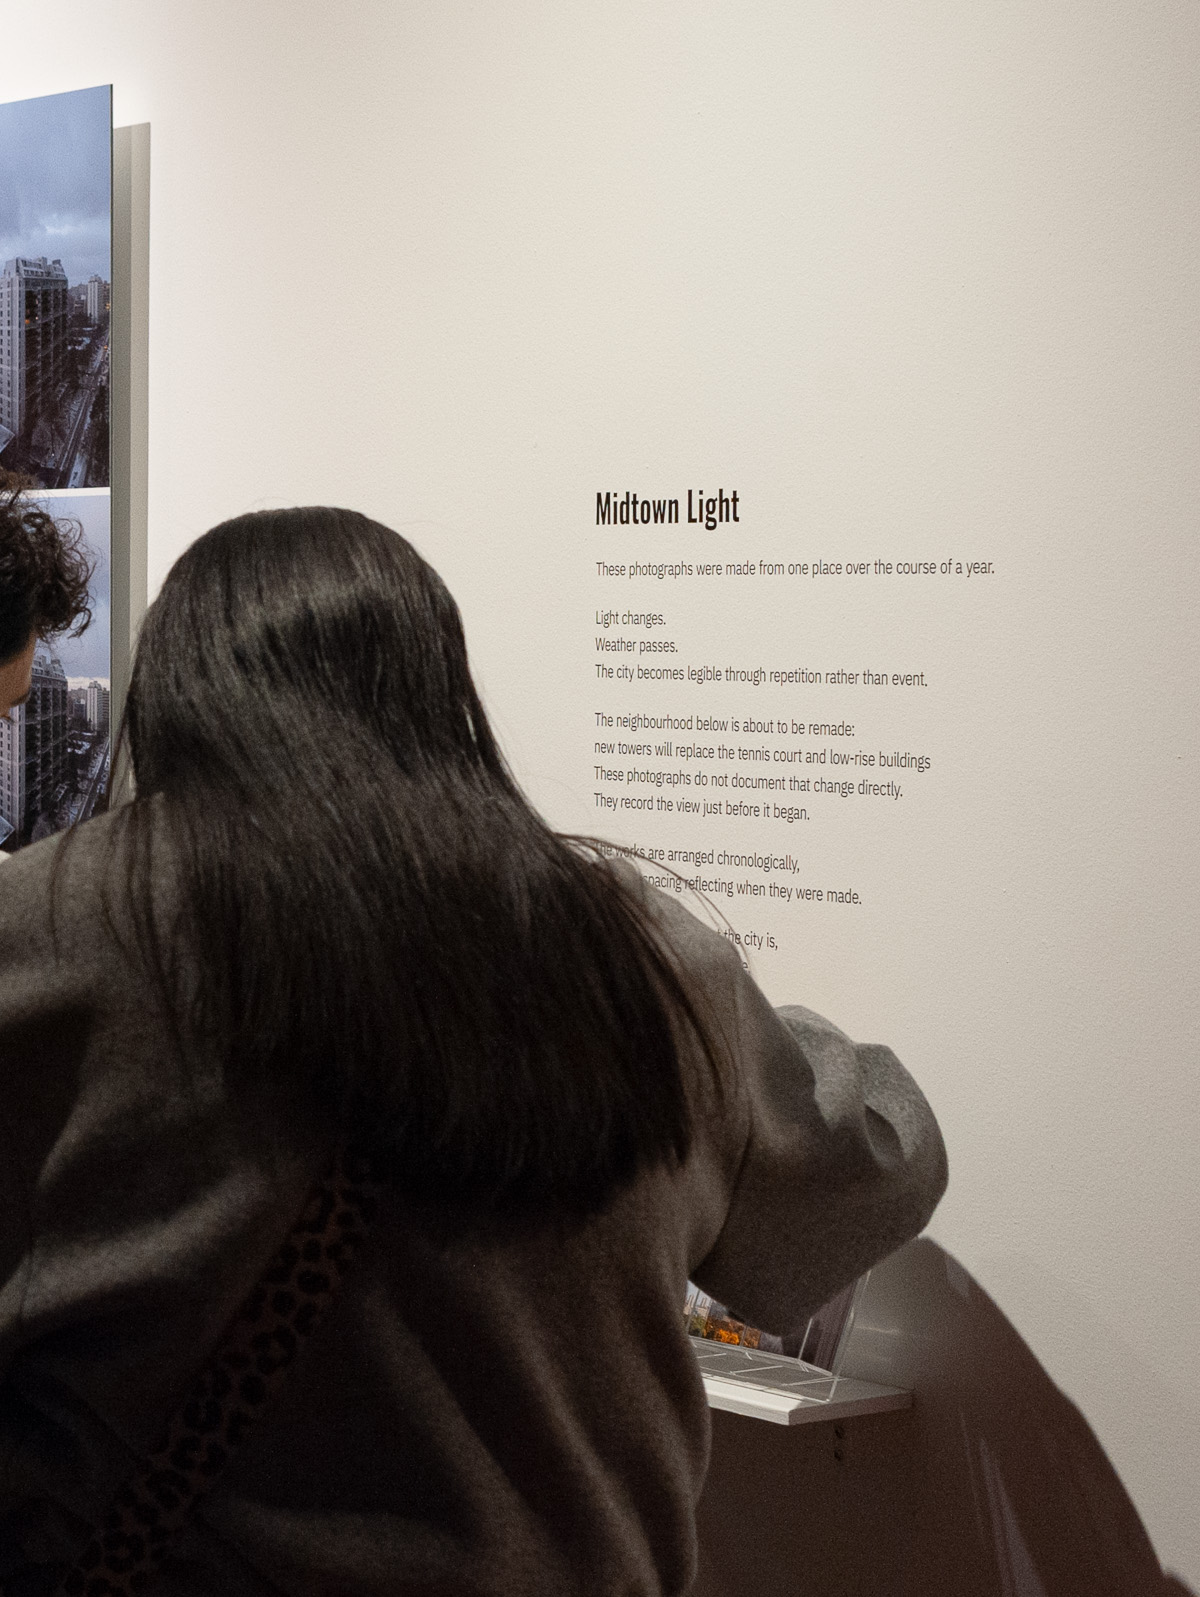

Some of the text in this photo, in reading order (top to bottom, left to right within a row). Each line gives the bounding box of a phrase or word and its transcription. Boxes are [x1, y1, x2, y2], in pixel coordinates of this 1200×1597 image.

[596, 488, 739, 531] Midtown Light
[596, 558, 994, 579] These photographs were made from one place over the course of a year.
[596, 610, 666, 629] Light changes.
[595, 637, 678, 655] Weather passes.
[595, 664, 927, 687] The city becomes legible through repetition rather than event.
[595, 712, 854, 736] The neighbourhood below is about to be remade:
[595, 741, 931, 773] new towers will replace the tennis court and low-rise buildings
[594, 765, 903, 800] These photographs do not document that change directly.
[594, 793, 810, 823] They record the view just before it began.
[615, 845, 645, 858] works
[647, 849, 665, 861] are
[667, 849, 714, 866] arranged
[717, 850, 799, 874] chronologically,
[685, 875, 734, 897] reflecting
[736, 880, 765, 896] when
[769, 882, 793, 902] they
[796, 888, 823, 901] were
[827, 888, 862, 904] made.
[744, 931, 763, 950] city
[767, 932, 778, 951] is,
